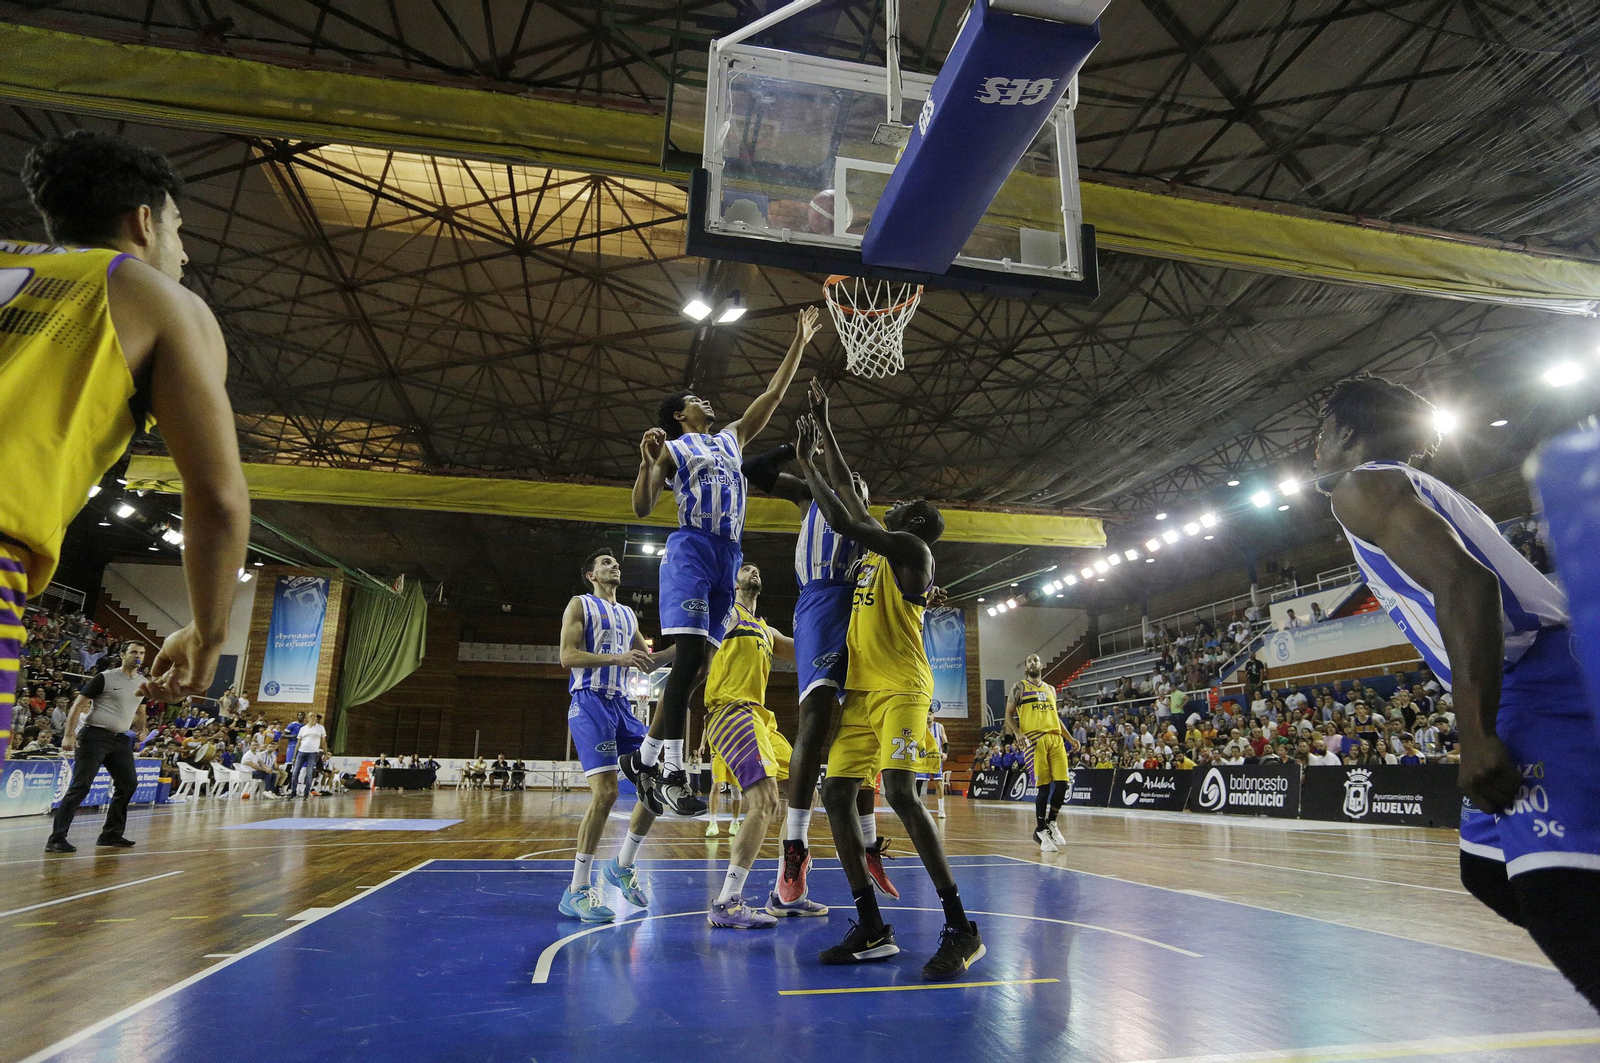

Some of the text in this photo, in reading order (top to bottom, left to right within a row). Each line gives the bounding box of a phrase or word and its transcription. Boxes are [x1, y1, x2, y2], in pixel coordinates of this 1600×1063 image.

[977, 77, 1057, 106] GES
[1293, 622, 1343, 639] Ayuntamiento
[285, 640, 316, 651] esfuerzo
[615, 631, 624, 646] 10
[1032, 703, 1054, 711] HOMS
[890, 737, 919, 762] 24
[92, 775, 110, 783] uelva
[1229, 774, 1288, 792] baloncesto
[1072, 791, 1091, 800] HUELVA
[1373, 793, 1414, 801] Ayuntamiento
[1372, 801, 1423, 815] HUELVA
